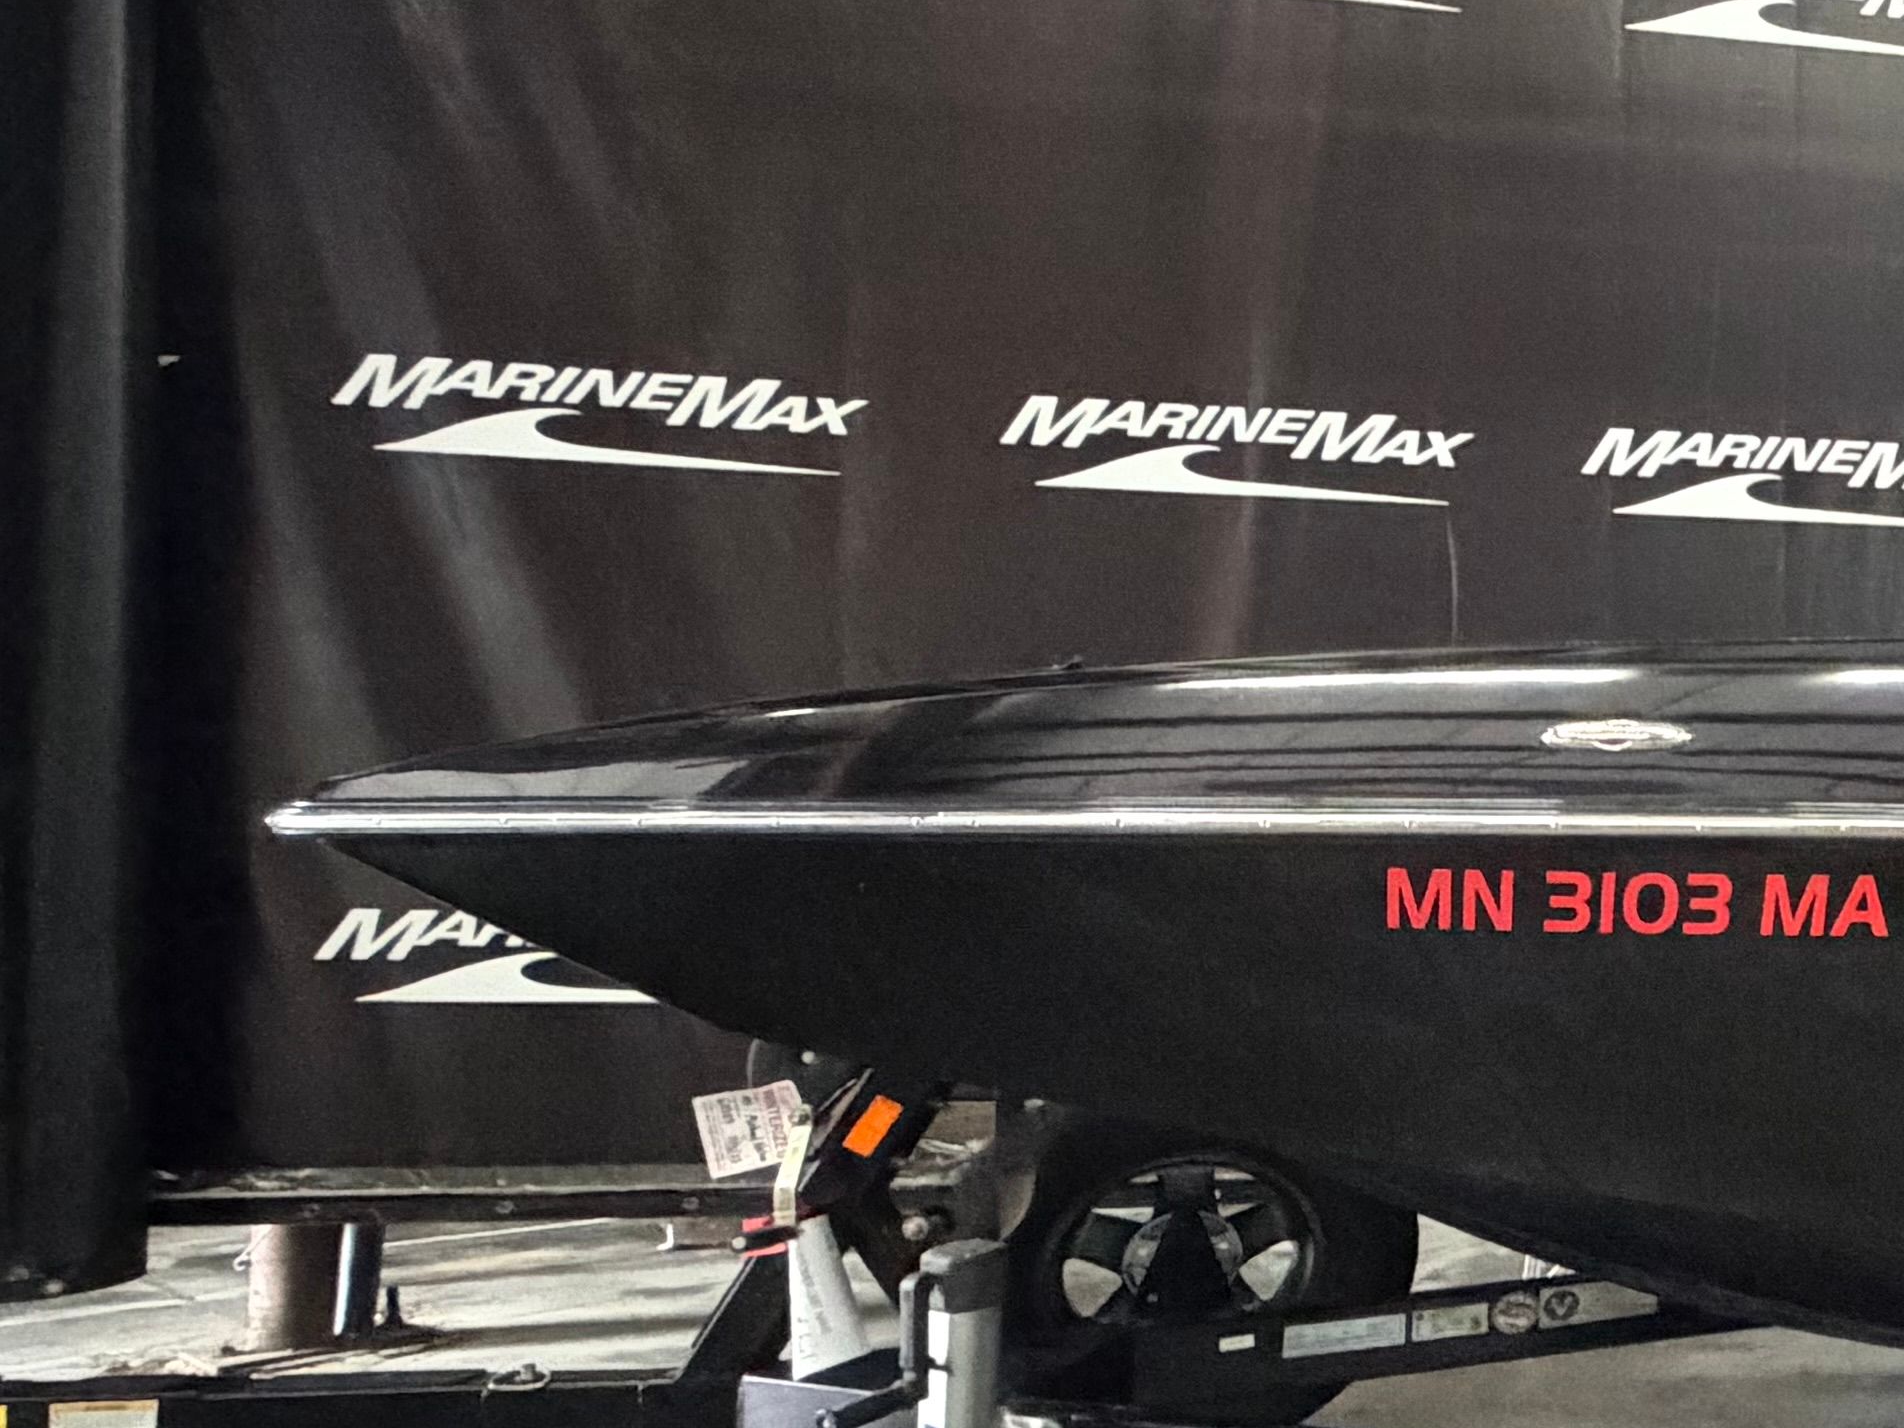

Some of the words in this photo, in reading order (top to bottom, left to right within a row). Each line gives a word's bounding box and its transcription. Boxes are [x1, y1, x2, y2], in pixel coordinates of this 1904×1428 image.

[1386, 868, 1514, 931] MN
[1543, 871, 1732, 936] 3103
[1760, 874, 1889, 938] MA
